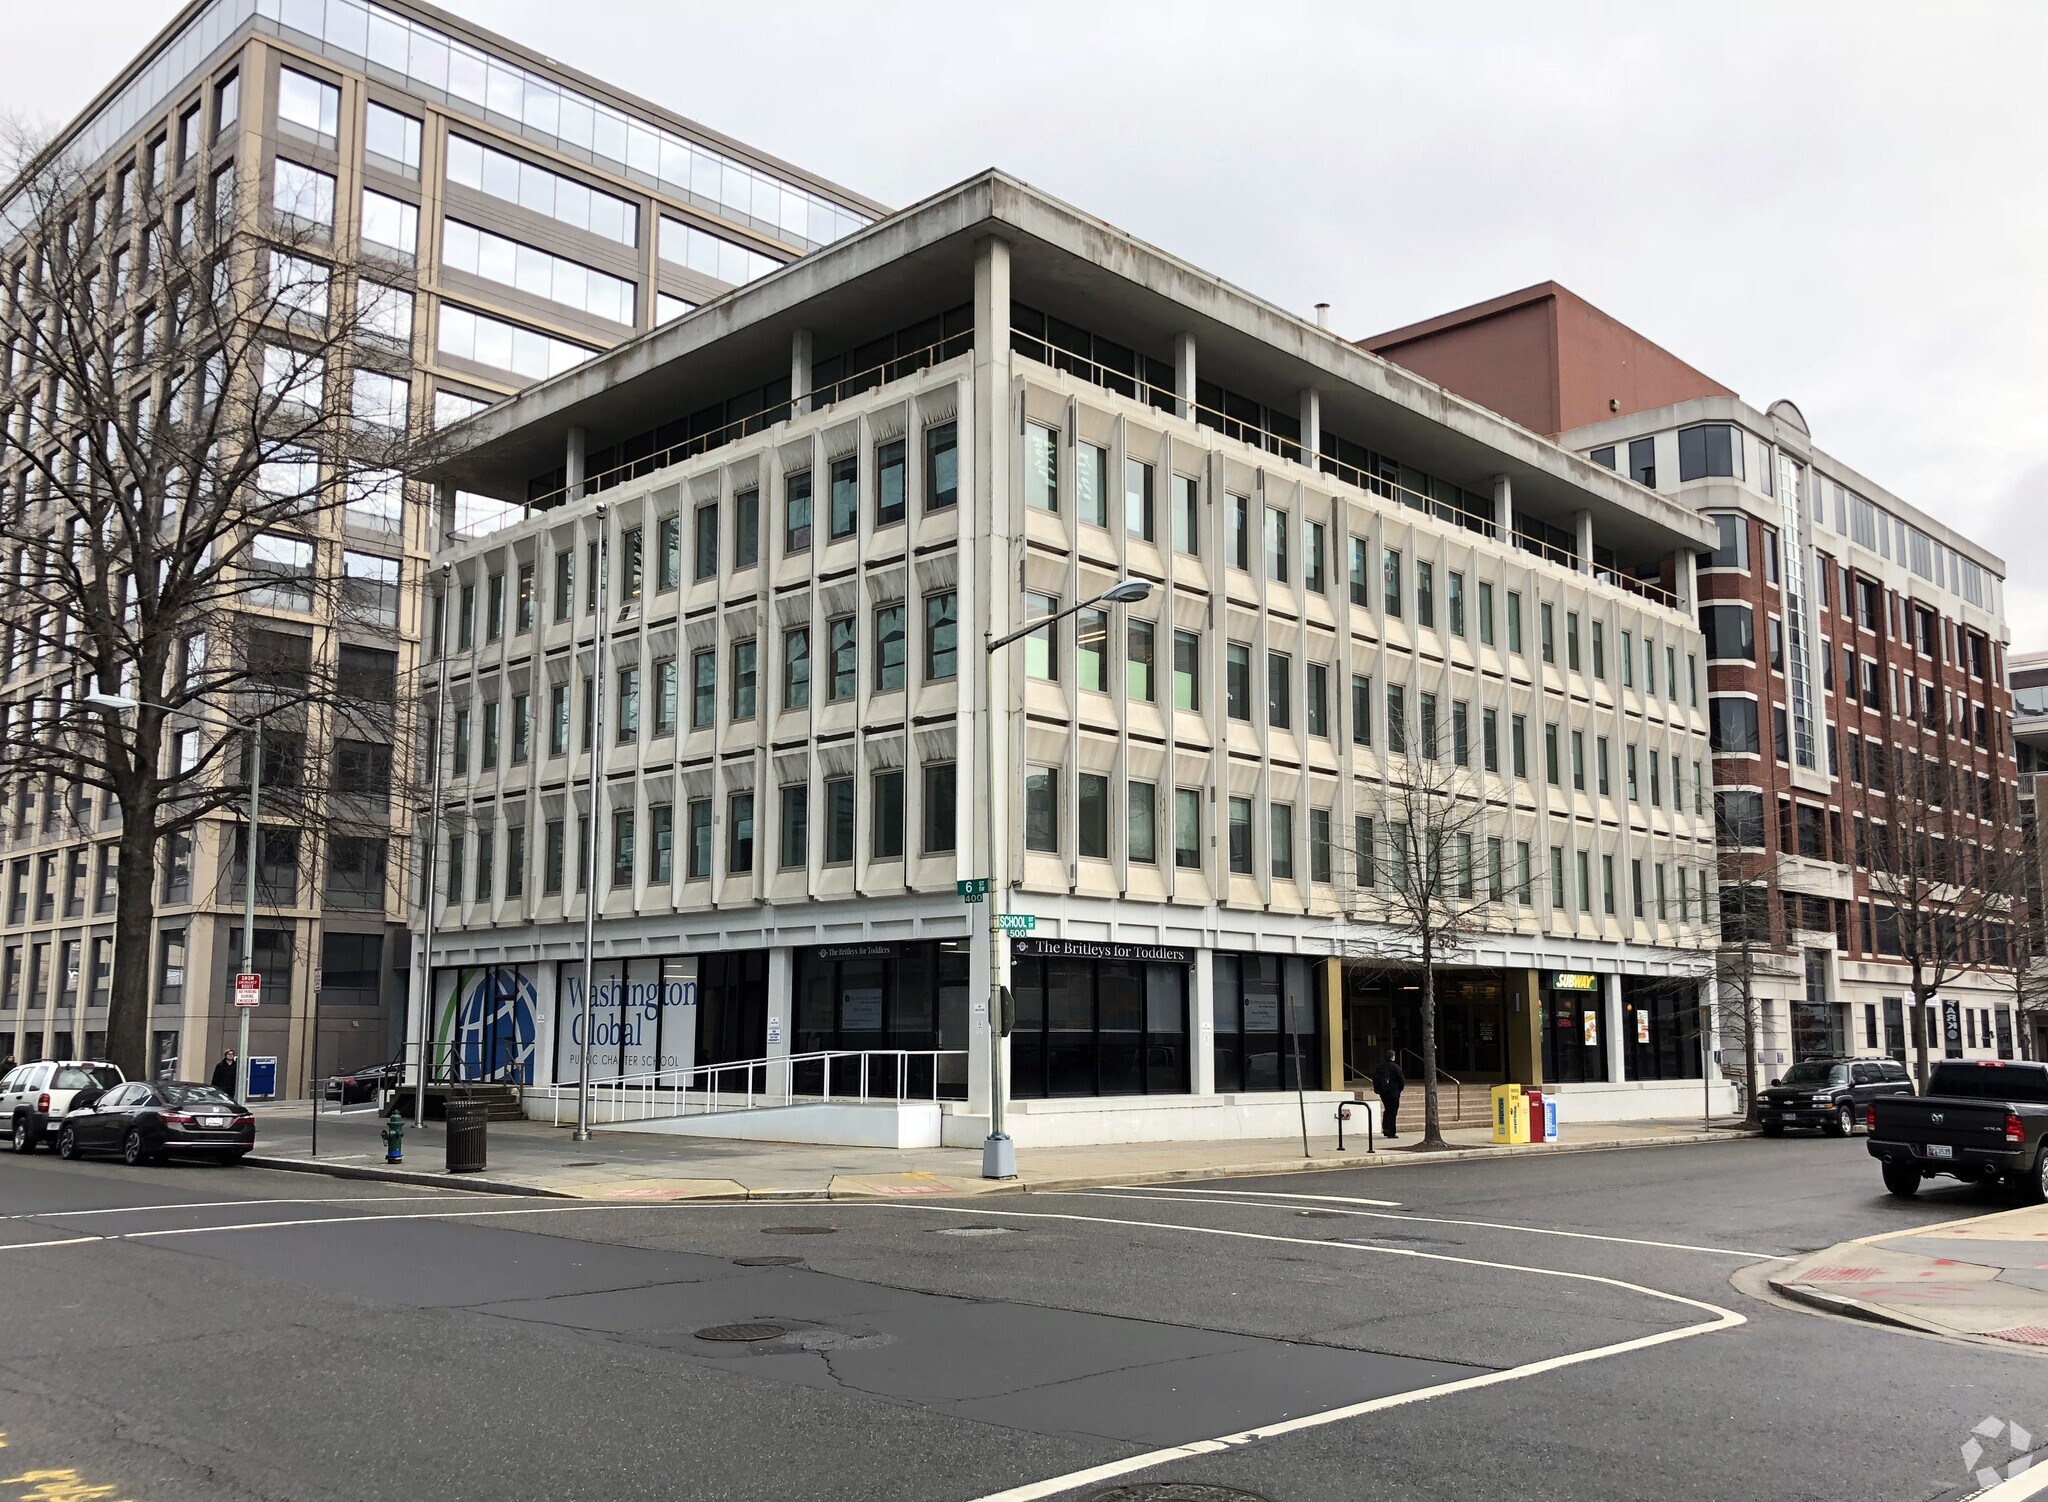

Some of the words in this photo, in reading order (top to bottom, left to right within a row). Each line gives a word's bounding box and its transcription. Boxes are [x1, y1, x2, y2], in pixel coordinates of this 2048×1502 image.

[965, 881, 973, 893] 6
[965, 894, 983, 903] 400
[999, 915, 1027, 928] SCHOOL
[1009, 929, 1026, 938] 500
[828, 947, 839, 956] The
[838, 947, 858, 957] Britleys
[858, 946, 867, 956] for
[867, 946, 891, 956] Toddlers
[1036, 940, 1061, 954] The
[1064, 942, 1112, 958] Britleys
[1113, 944, 1132, 957] for
[1133, 946, 1185, 960] Toddlers
[1556, 973, 1596, 990] SUBWAY
[572, 1012, 643, 1047] Global
[601, 1054, 639, 1066] CHATER
